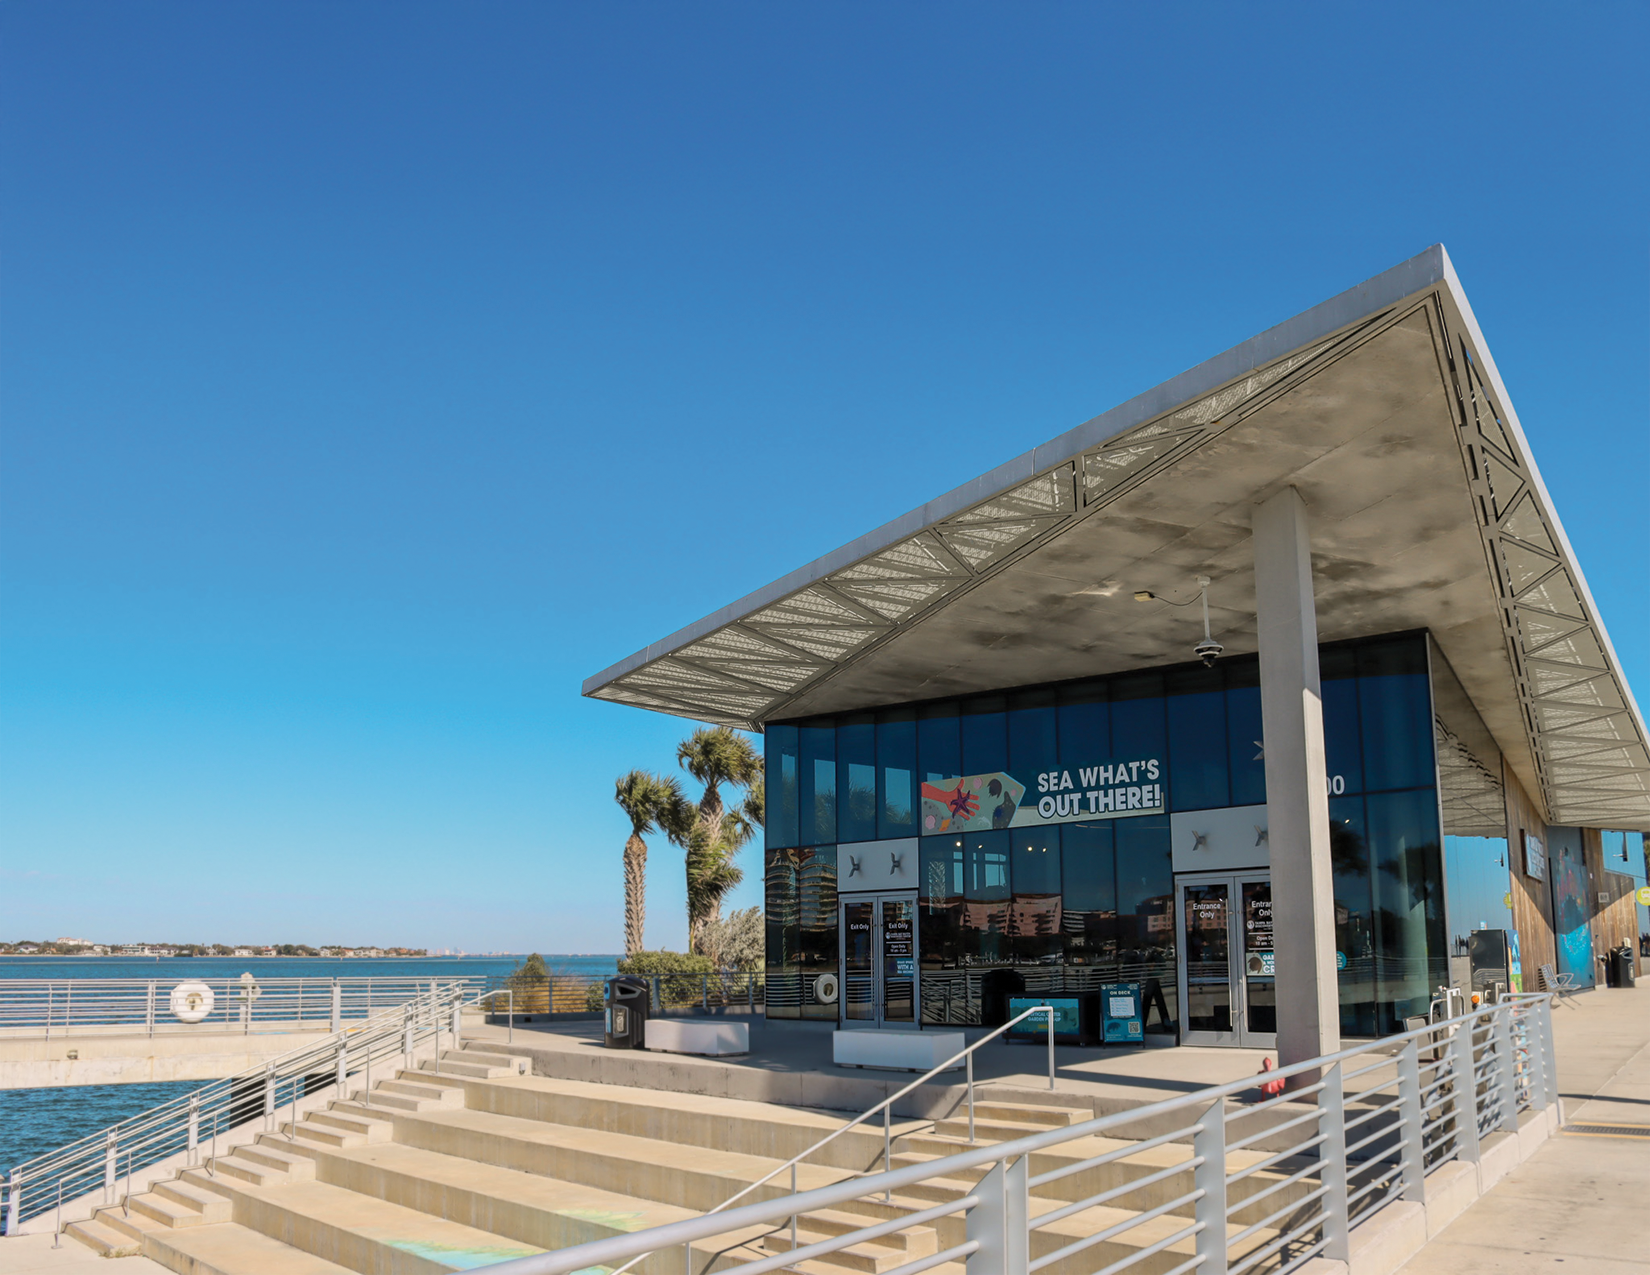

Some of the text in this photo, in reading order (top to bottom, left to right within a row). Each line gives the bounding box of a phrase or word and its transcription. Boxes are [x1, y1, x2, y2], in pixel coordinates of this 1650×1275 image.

[1037, 759, 1160, 793] SEA WHAT'S
[1038, 783, 1161, 818] OUT THERE!
[1199, 911, 1215, 919] Only
